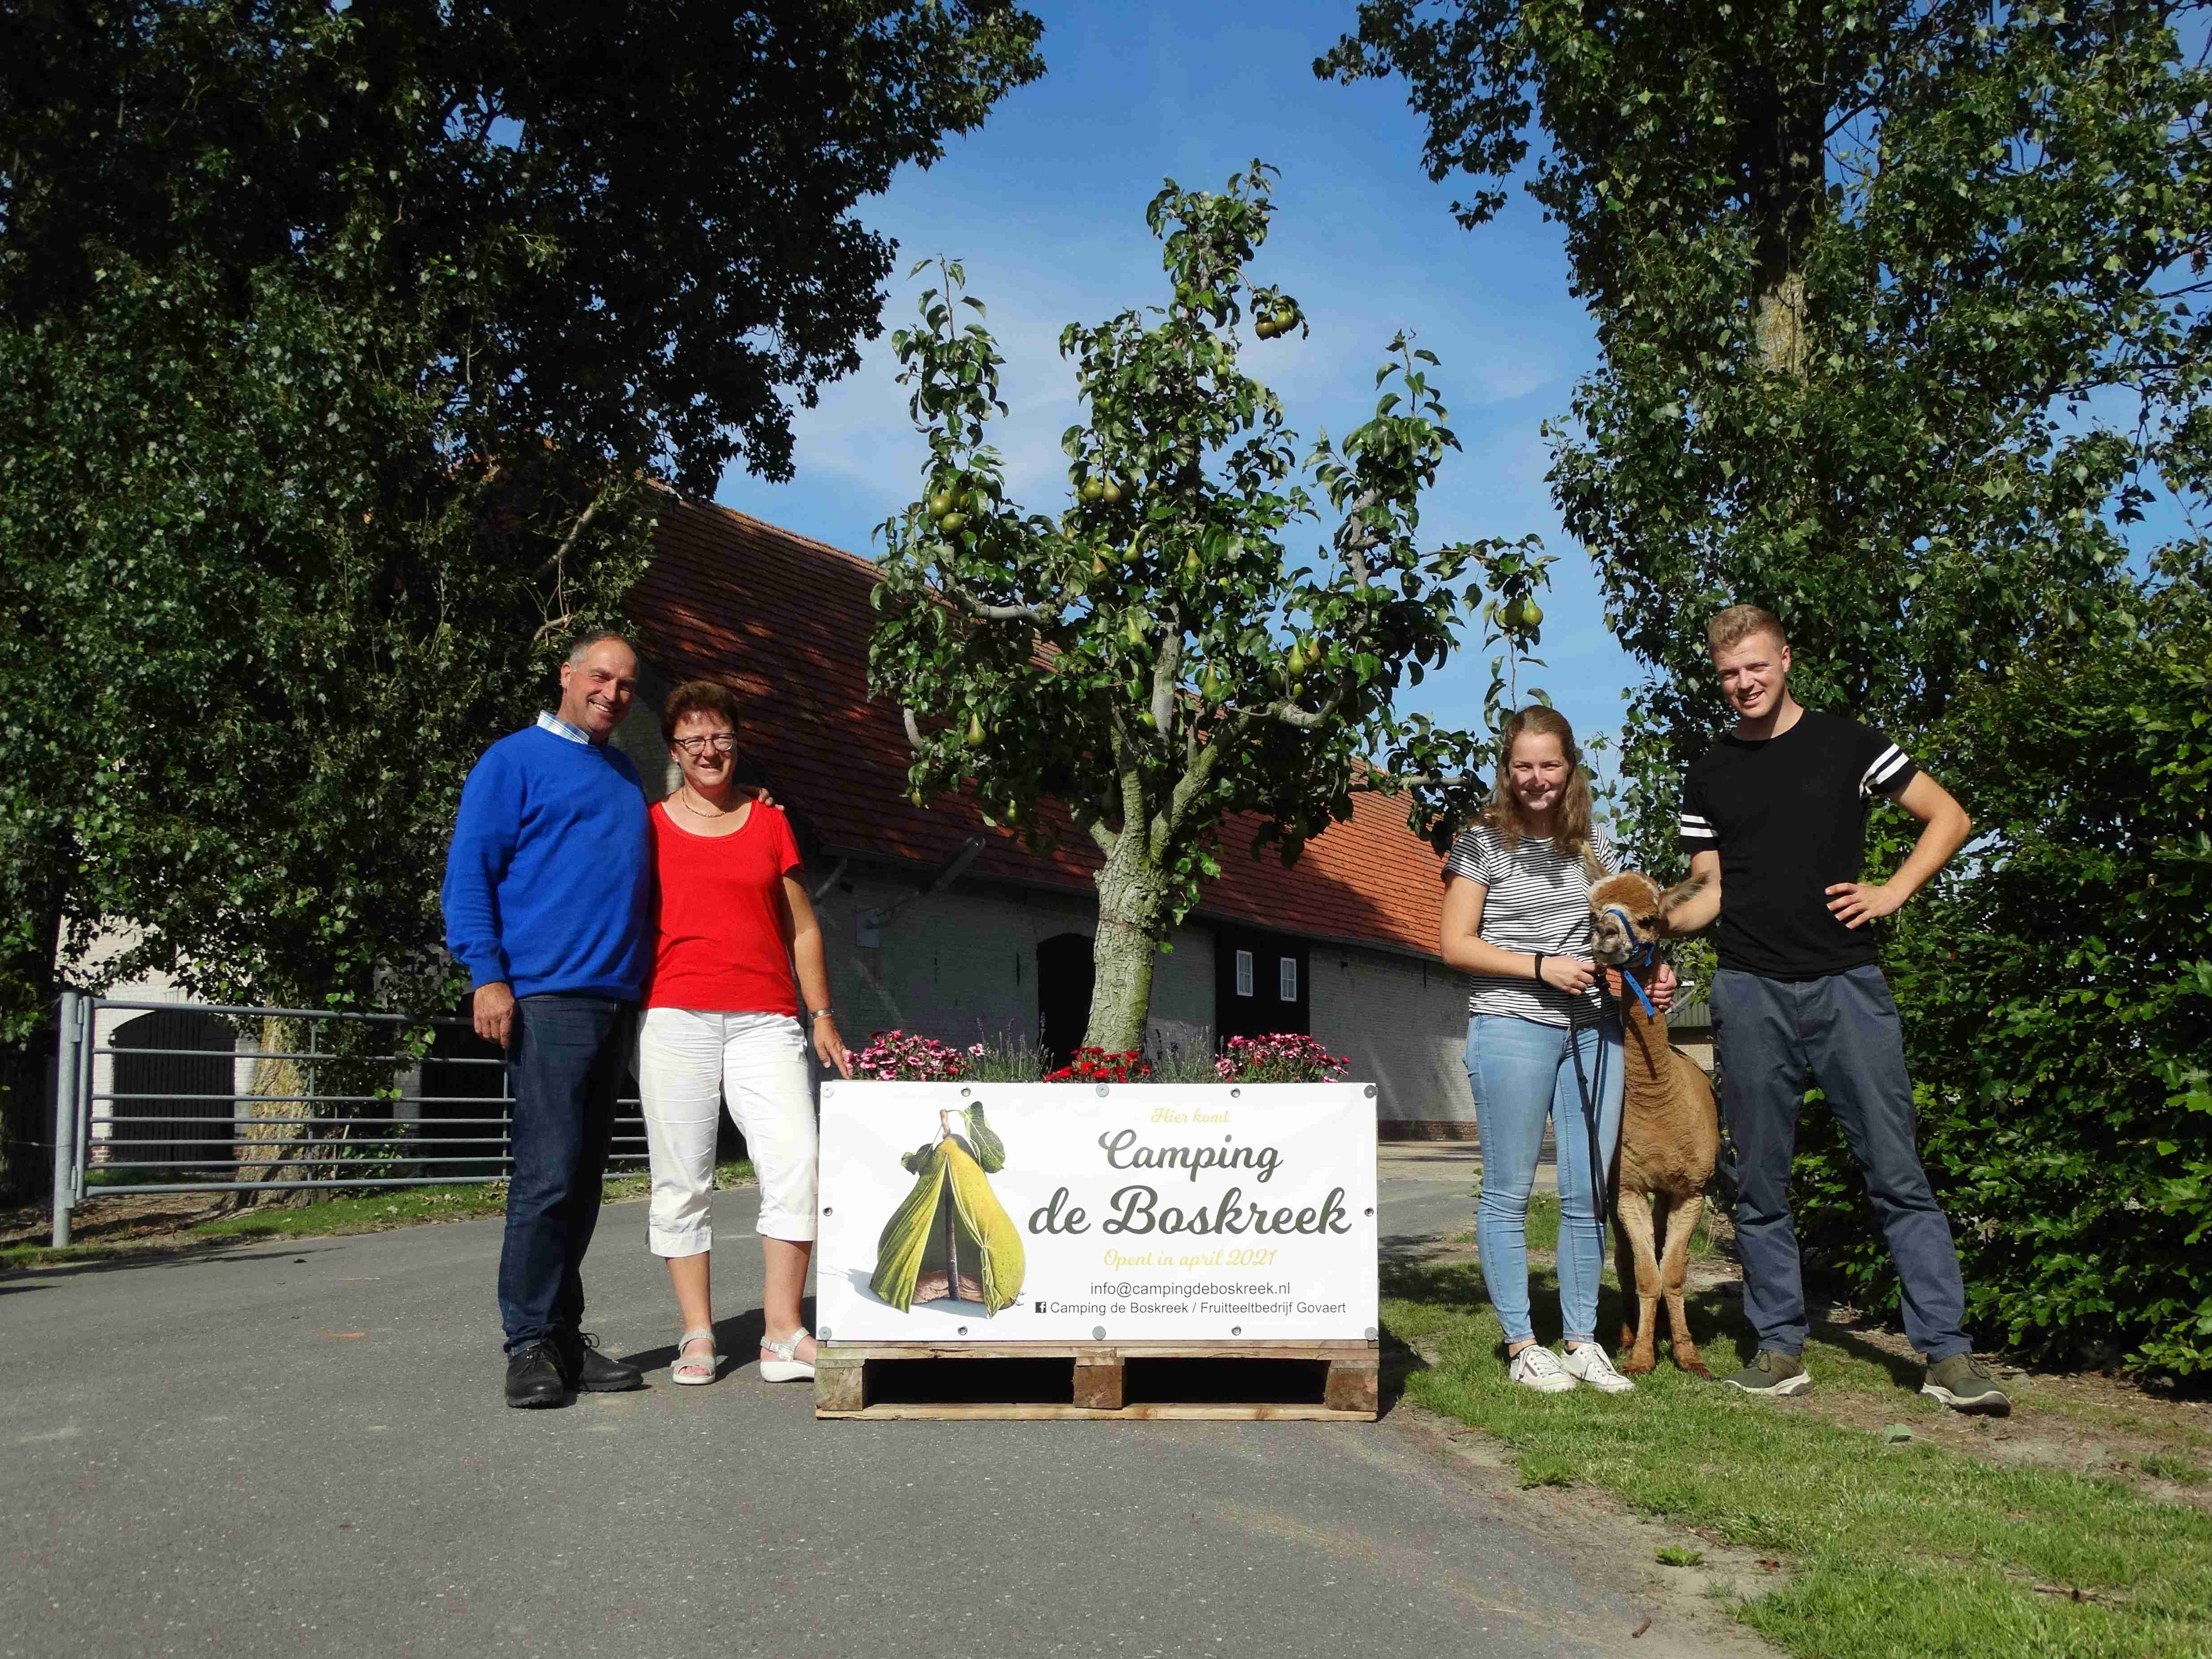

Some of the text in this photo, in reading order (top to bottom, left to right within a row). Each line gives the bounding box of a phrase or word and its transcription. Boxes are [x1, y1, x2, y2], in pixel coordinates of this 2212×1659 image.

[1151, 1107, 1229, 1123] Hier komt
[1098, 1129, 1284, 1183] Camping
[1028, 1185, 1352, 1235] de Boskreek
[1104, 1249, 1279, 1272] Opent in april 2021
[1091, 1282, 1290, 1298] info@campingdeboskreek.nl
[1051, 1302, 1106, 1316] Camping
[1110, 1302, 1126, 1313] de
[1130, 1302, 1188, 1313] Boskreek
[1201, 1302, 1293, 1316] Fruitteeltbedrijf
[1297, 1302, 1346, 1313] Govaert
